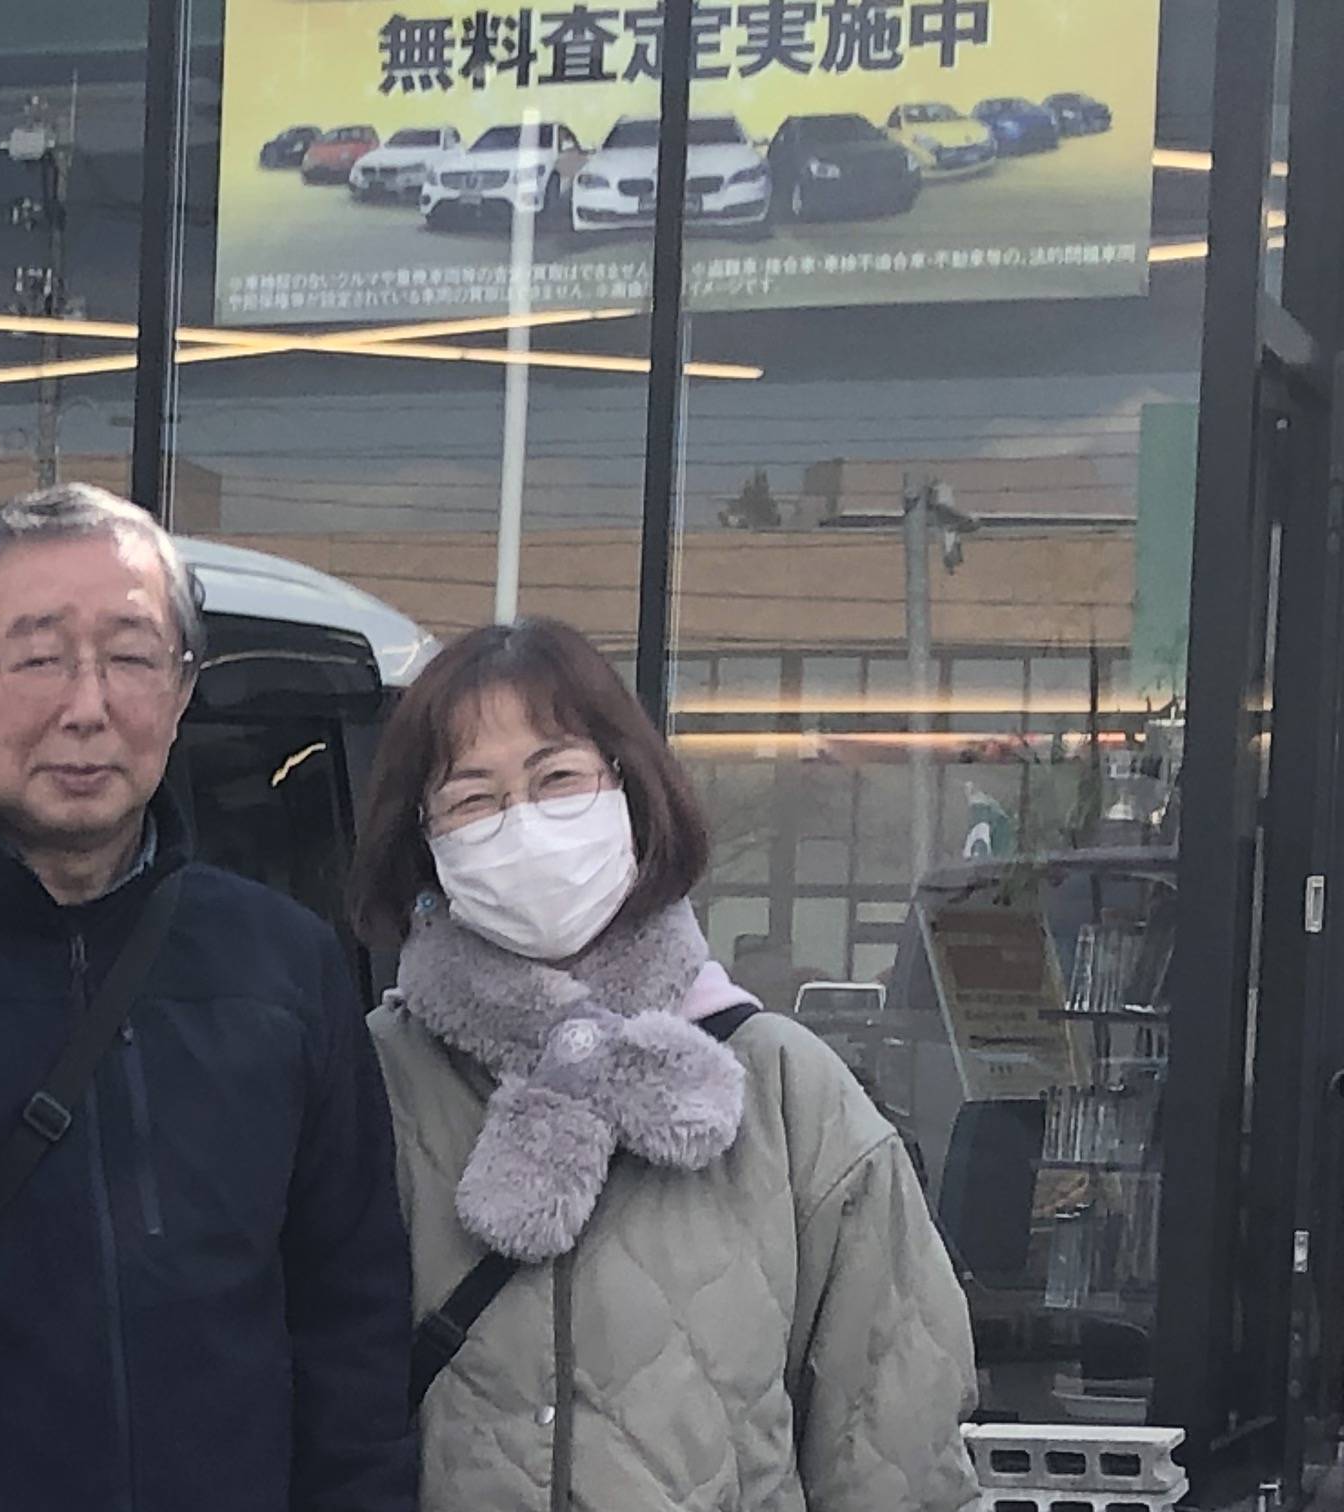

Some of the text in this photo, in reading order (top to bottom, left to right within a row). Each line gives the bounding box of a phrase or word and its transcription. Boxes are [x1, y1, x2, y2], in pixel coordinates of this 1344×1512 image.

[378, 0, 988, 94] 無料査定実施中
